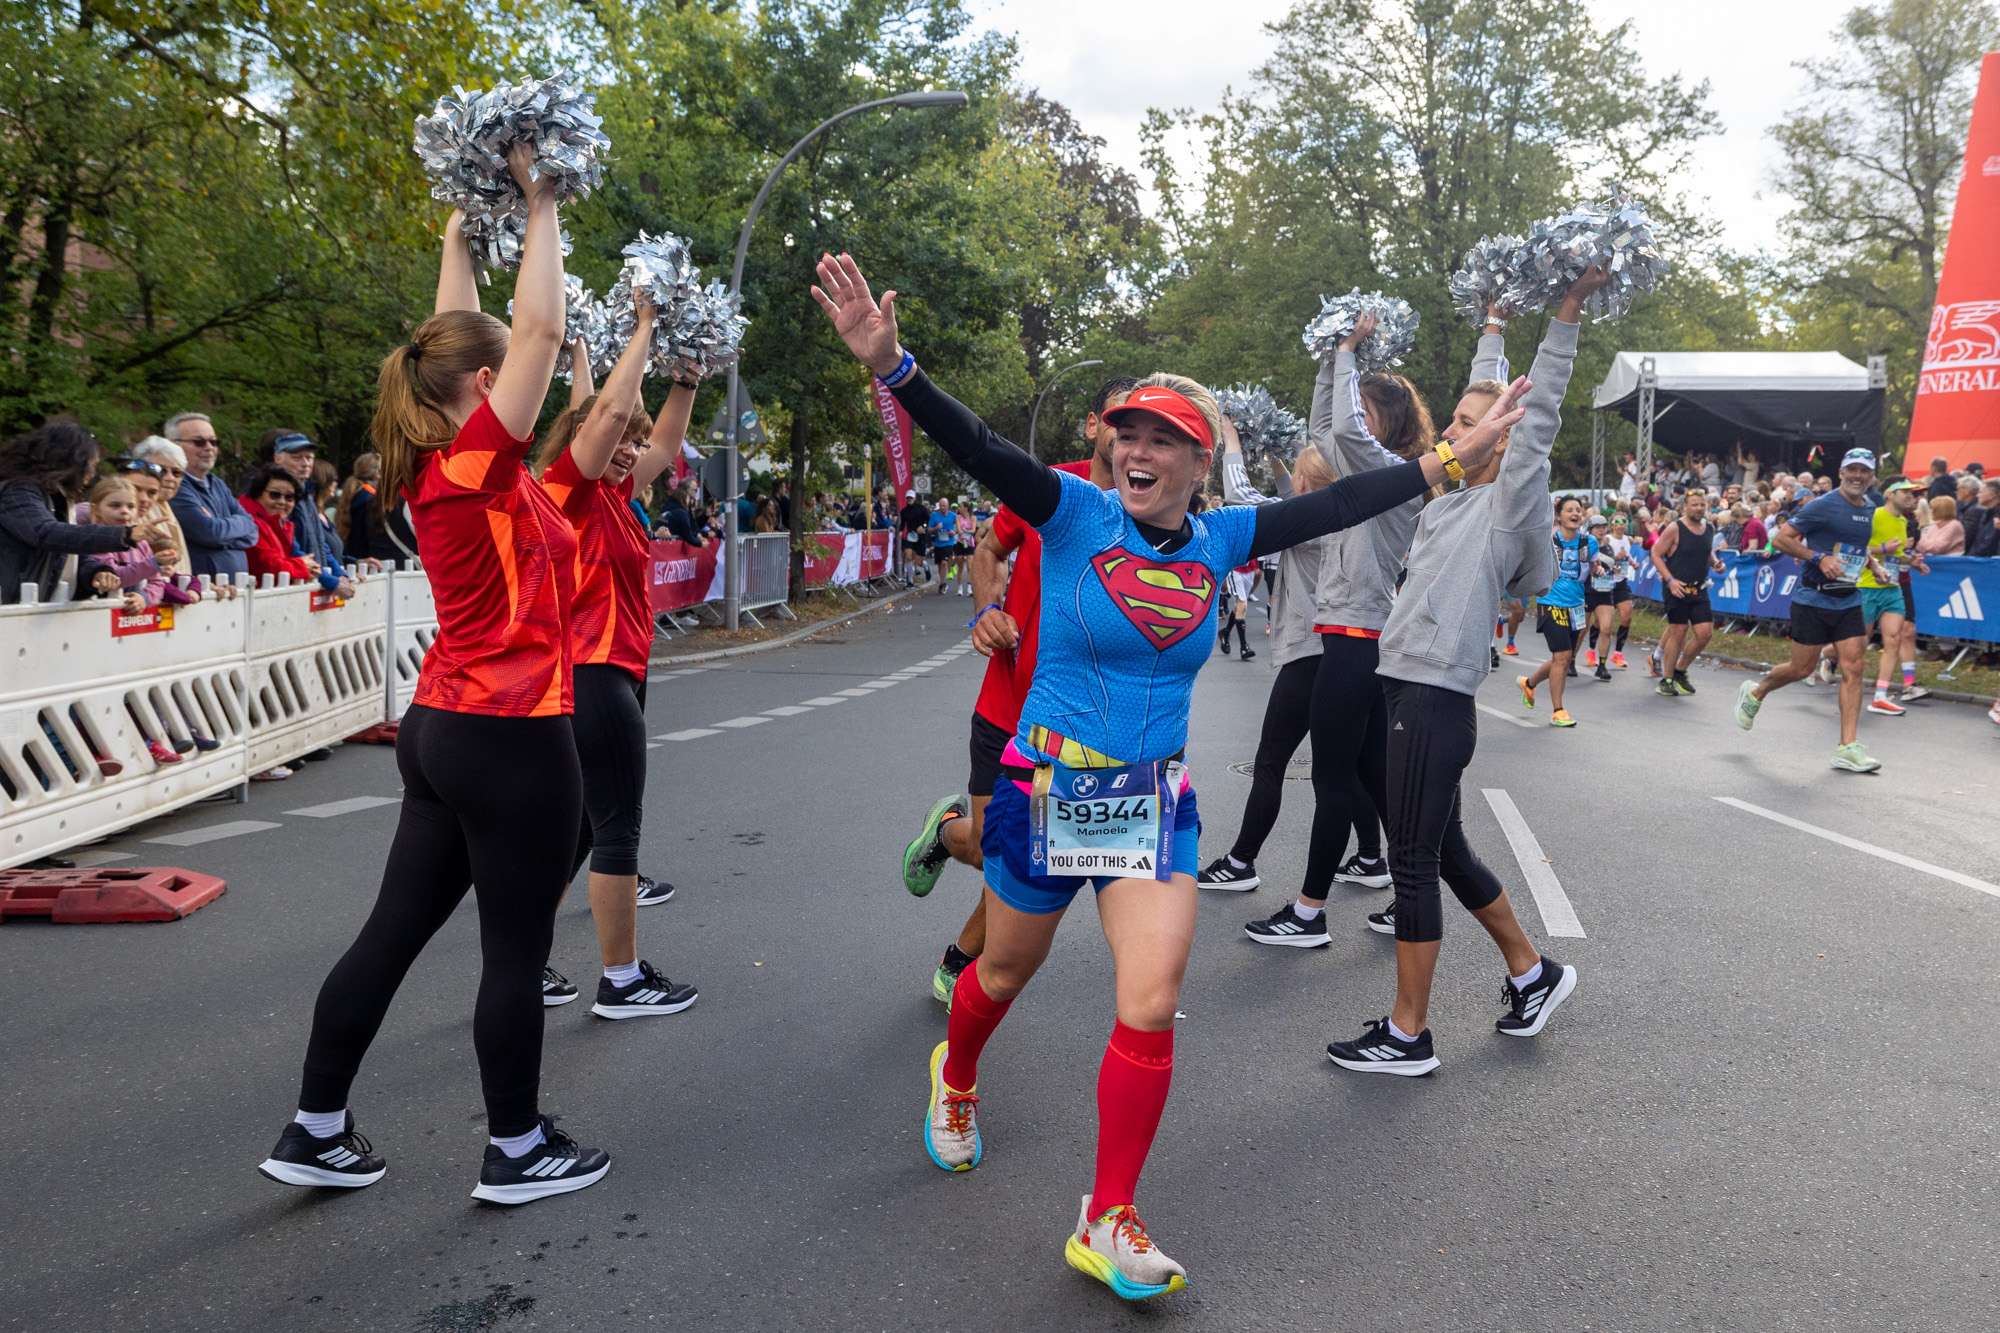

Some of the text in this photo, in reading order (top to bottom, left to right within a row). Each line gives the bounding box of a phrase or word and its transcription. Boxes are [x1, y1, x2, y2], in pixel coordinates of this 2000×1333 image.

[1057, 799, 1148, 824] 59344
[1077, 826, 1128, 836] Manoela
[1138, 838, 1145, 846] F
[1050, 855, 1127, 868] YOU GOT THIS
